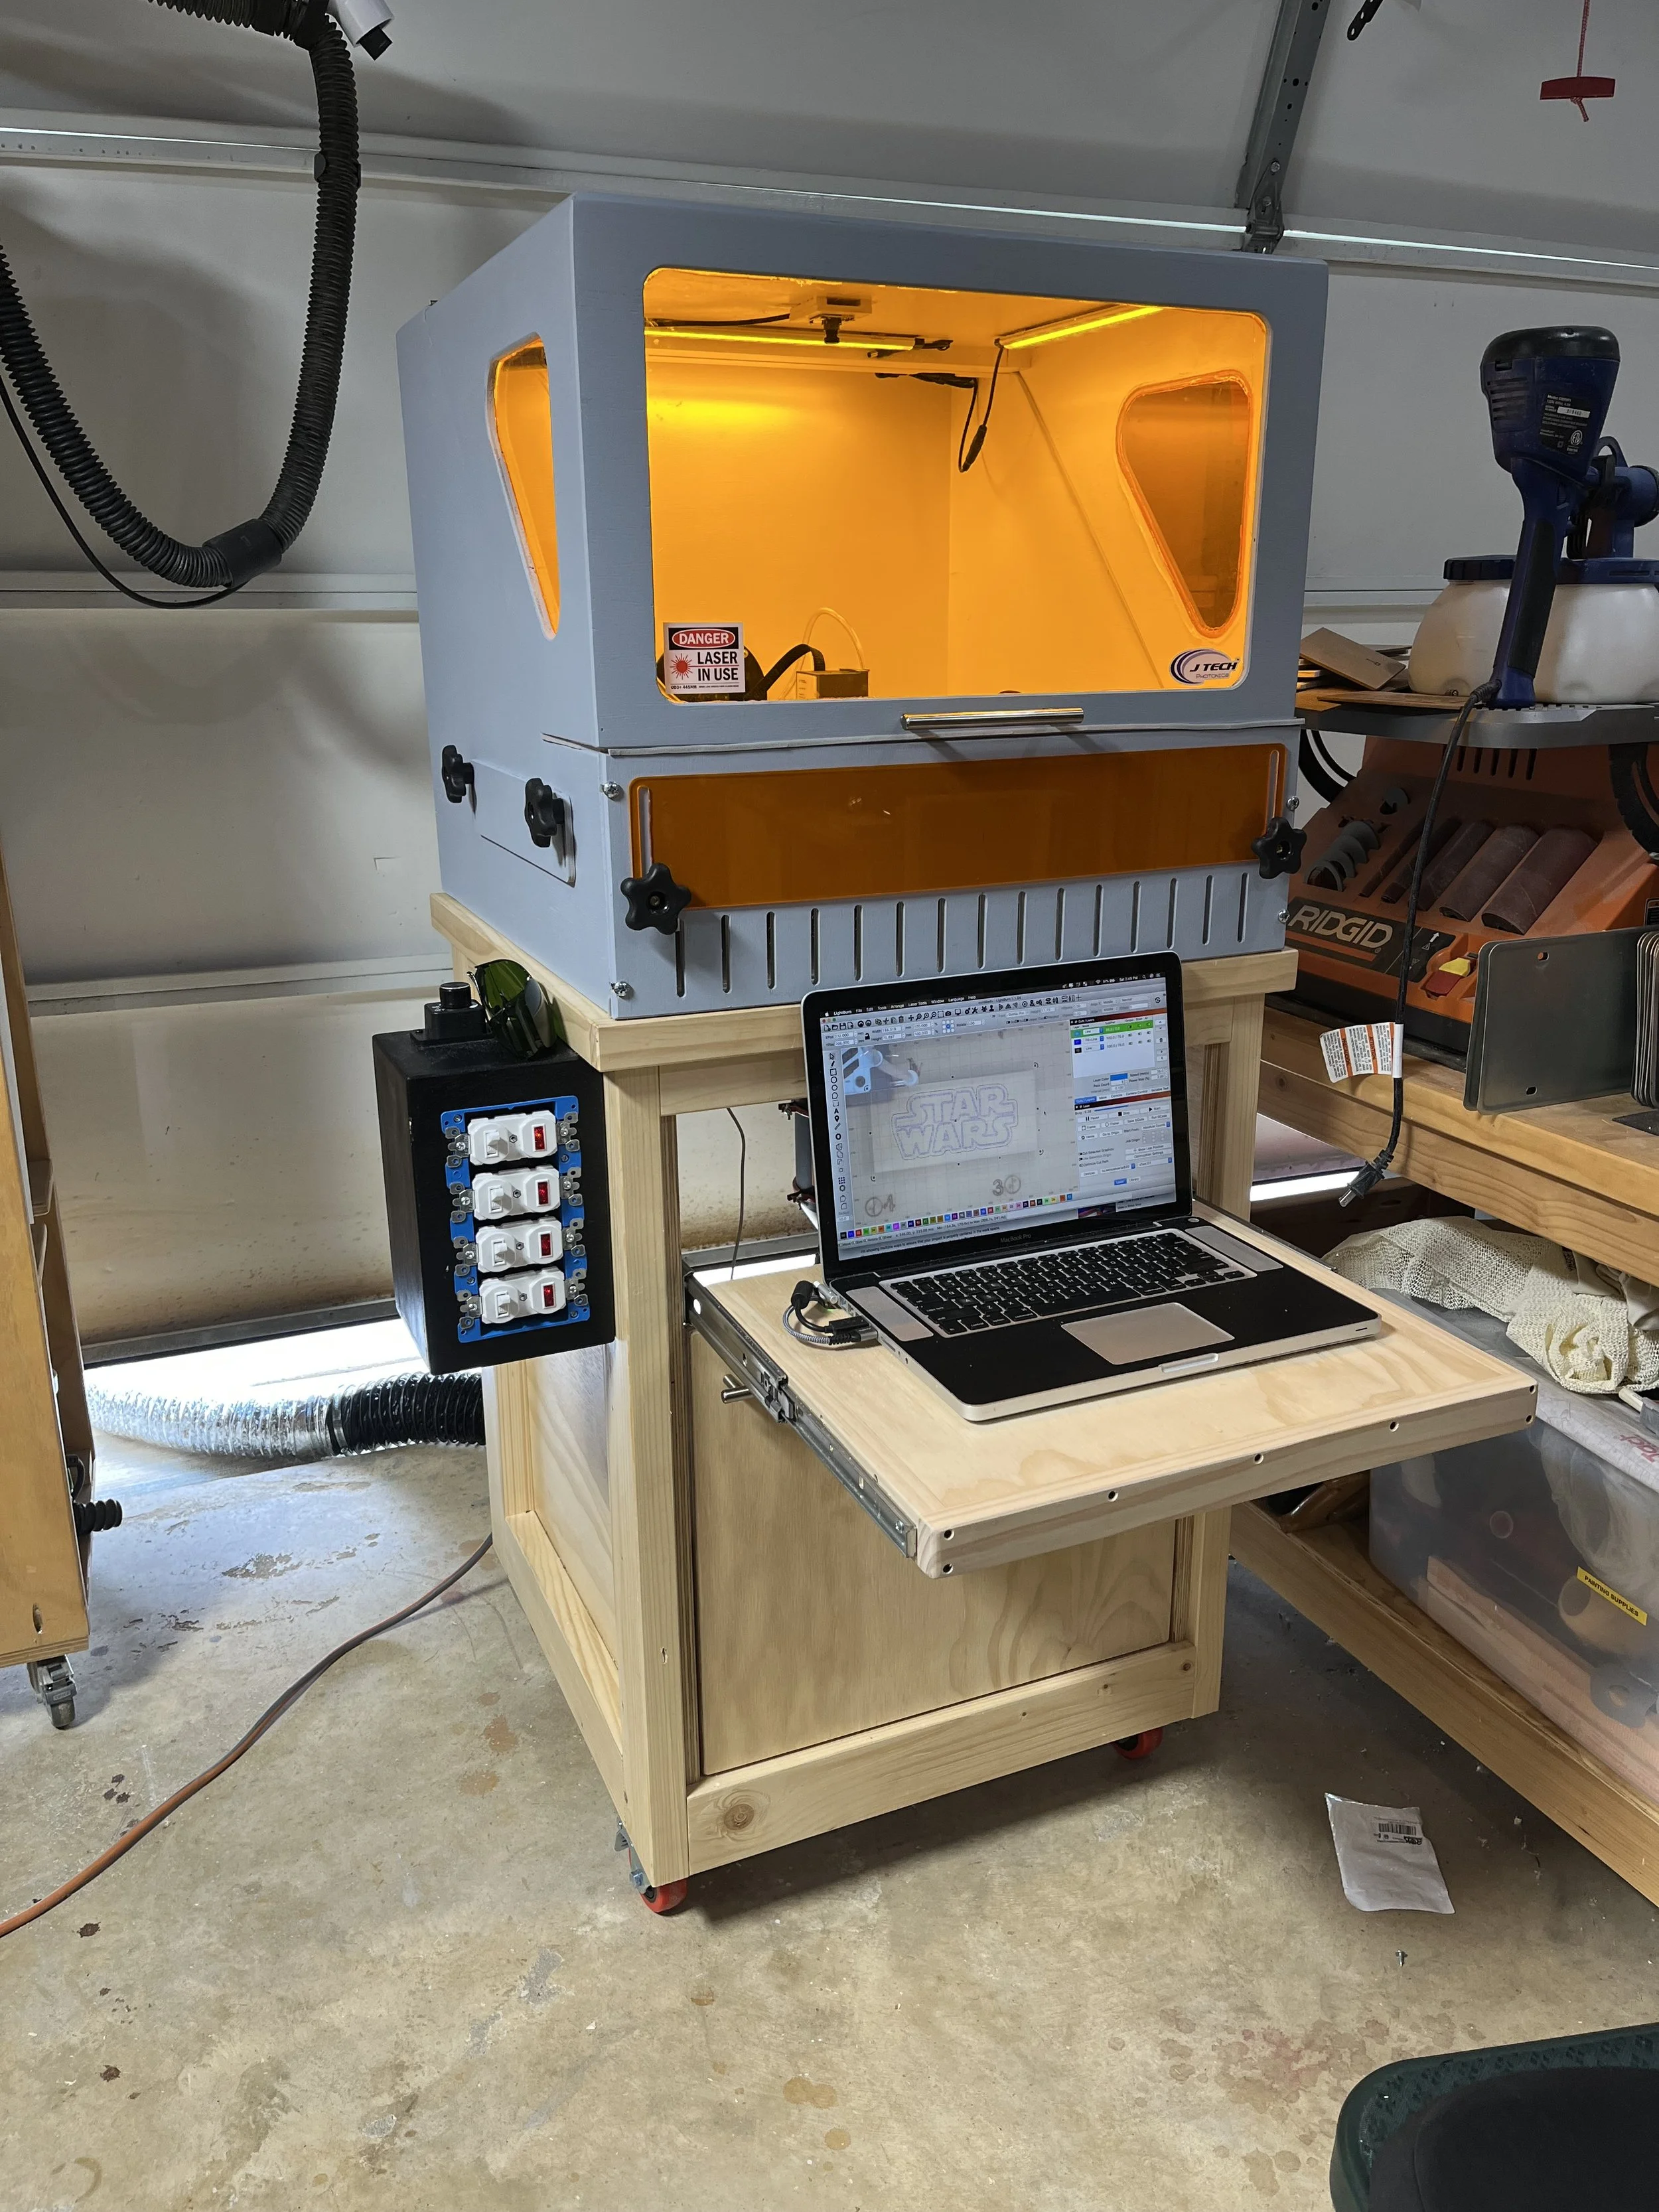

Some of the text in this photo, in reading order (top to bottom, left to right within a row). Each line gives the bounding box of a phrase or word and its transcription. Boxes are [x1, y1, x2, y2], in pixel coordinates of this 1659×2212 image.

[679, 633, 729, 644] DANGER
[697, 651, 737, 664] LASER
[1203, 662, 1238, 672] TECH
[698, 668, 738, 681] IN USE
[1288, 905, 1393, 948] RIDGID
[895, 1086, 1016, 1128] STAR
[896, 1115, 1016, 1158] WARS
[1584, 1576, 1639, 1617] PAINTING SUPPLIES
